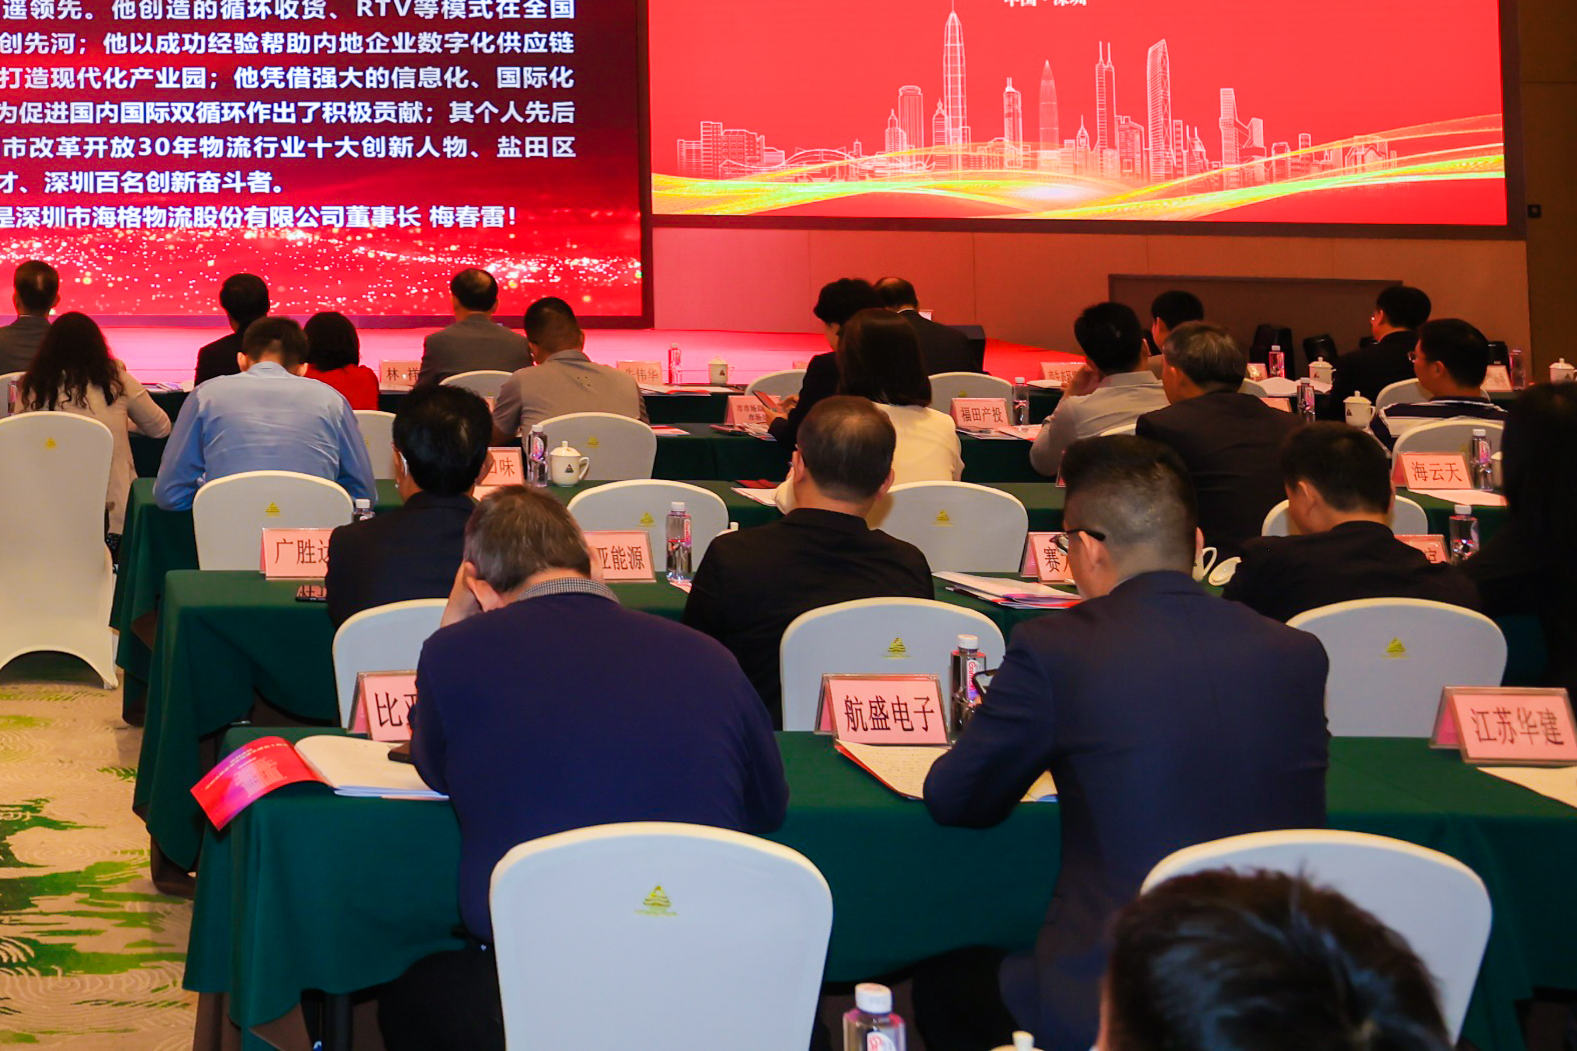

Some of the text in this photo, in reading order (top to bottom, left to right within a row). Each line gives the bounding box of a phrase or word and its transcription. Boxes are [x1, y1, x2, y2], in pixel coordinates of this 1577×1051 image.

[960, 406, 1004, 423] 福田产投
[1410, 461, 1463, 483] 海云天
[844, 694, 935, 733] 航盛电子
[1470, 707, 1565, 746] 江苏华建
